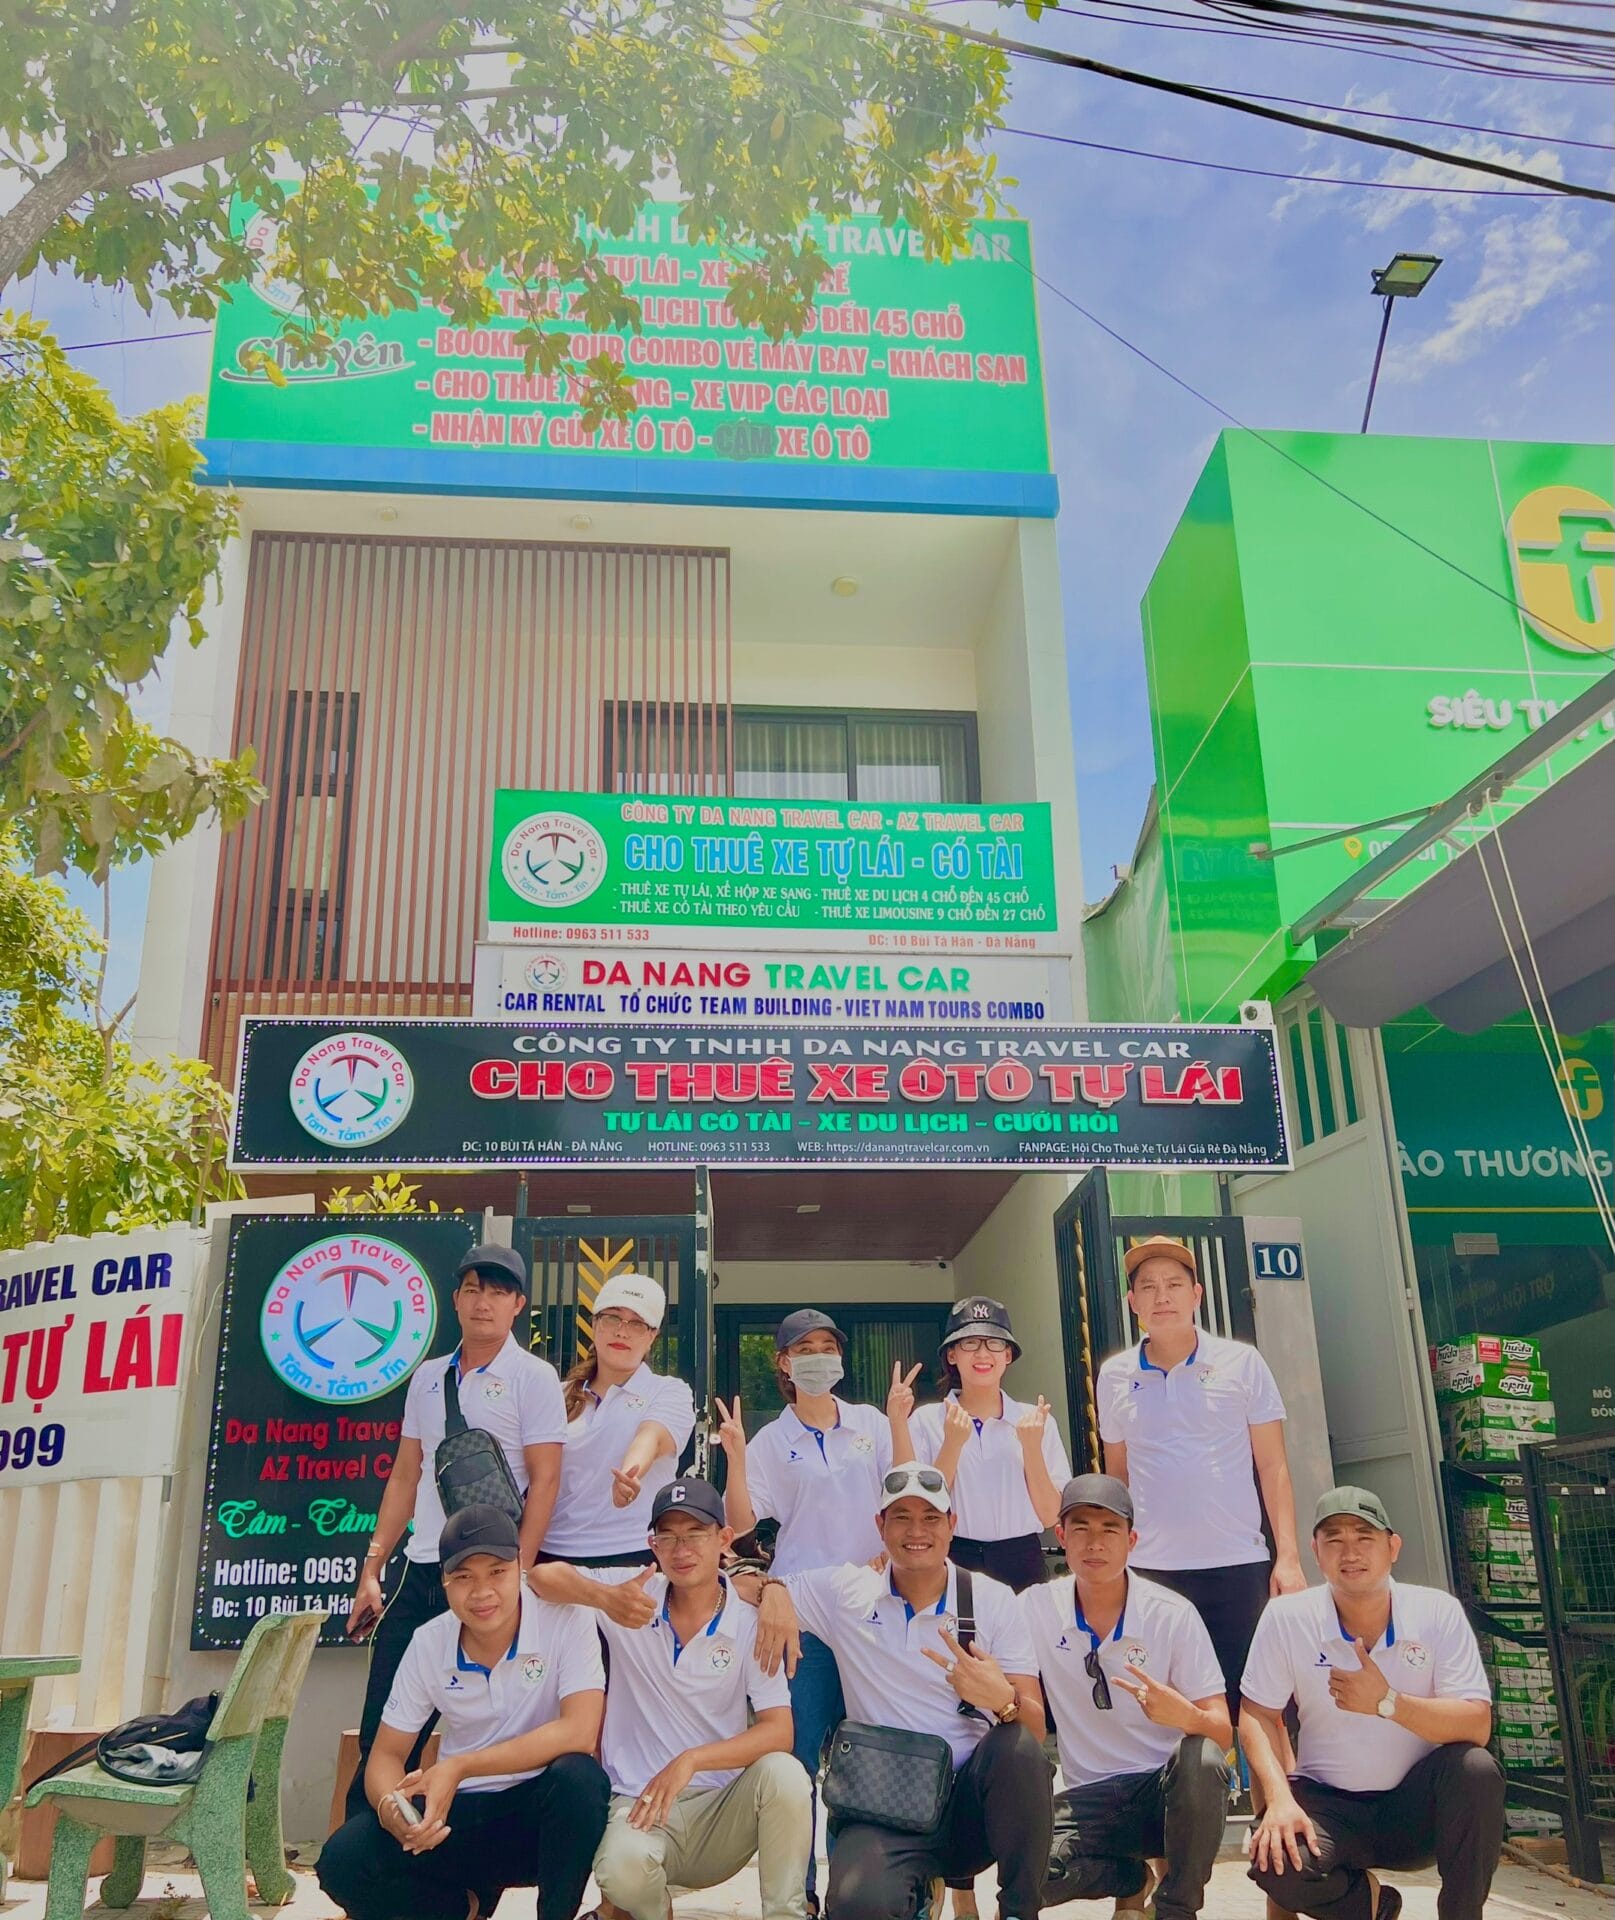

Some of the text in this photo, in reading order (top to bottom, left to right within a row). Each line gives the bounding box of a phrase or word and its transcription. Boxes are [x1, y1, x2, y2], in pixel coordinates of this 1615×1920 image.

[641, 253, 679, 286] LÁI
[643, 296, 702, 328] LỊCH
[874, 310, 908, 337] 45
[911, 304, 965, 341] CHỖ
[629, 338, 1028, 387] COMBO VÉ MÁY BAY KHÁCH SẠN
[434, 370, 889, 423] CHO THUÊ XE VIP CÁC LOẠI
[431, 408, 871, 460] NHẬN KÝ XE Ô TÔ XE Ô TÔ
[1427, 689, 1513, 730] SIÊU
[621, 800, 1024, 832] CÔNG TY NANG TRAVEL CAR AZ TRAVEL CAR
[624, 833, 1023, 884] CHO THUÊ XE TỰ LÁI CÓ TÀI
[620, 881, 812, 900] THUÊ XE XE SANG
[821, 886, 851, 902] THUÊ
[854, 889, 869, 901] XE
[872, 890, 889, 902] DU
[921, 890, 928, 902] 4
[986, 892, 1000, 904] 45
[620, 899, 651, 914] THUÊ
[654, 902, 669, 914] XE
[716, 903, 748, 916] THEO
[821, 904, 1015, 921] THUÊ XE LIMOUSINE 9 27
[513, 925, 650, 941] Hotline: 0963 511 533
[894, 935, 907, 947] 10
[582, 960, 631, 986] DA
[643, 961, 751, 988] NANG
[764, 964, 888, 993] TRAVEL
[897, 965, 971, 993] CAR
[504, 992, 538, 1012] CAR
[542, 992, 606, 1013] RENTAL
[646, 991, 692, 1014] CHỨC
[700, 996, 747, 1015] TEAM
[754, 996, 832, 1017] BUILDING
[844, 998, 881, 1018] VIET
[885, 1000, 925, 1018] NAM
[928, 1000, 982, 1019] TOURS
[987, 1001, 1045, 1020] COMBO
[512, 1031, 1192, 1059] CÔNG TY TNHH DA NANG TRAVEL CAR
[469, 1056, 1244, 1109] CHO THUÊ XE ÔTÔ TỰ LÁI
[603, 1110, 645, 1134] TỰ
[649, 1108, 693, 1132] LÁI
[698, 1108, 740, 1132] CÓ
[744, 1108, 792, 1131] TÀI
[817, 1112, 852, 1132] XE
[858, 1112, 898, 1132] DU
[904, 1112, 969, 1135] LỊCH
[462, 1140, 482, 1153] ĐC:
[484, 1140, 498, 1153] 10
[500, 1138, 520, 1153] BÙI
[521, 1138, 536, 1153] TÁ
[537, 1138, 563, 1153] HÁN
[648, 1141, 771, 1154] HOTLINE: 0963 511 533
[797, 1141, 990, 1156] WEB: https://danangtravelcar.com.vn
[1018, 1142, 1070, 1154] FANPAGE:
[1091, 1142, 1112, 1154] Cho
[1113, 1143, 1139, 1154] Thuê
[1141, 1144, 1155, 1155] Xe
[1171, 1143, 1187, 1155] Lái
[1454, 1145, 1612, 1177] THƯƠNG
[91, 1252, 173, 1296] CAR
[1258, 1247, 1298, 1276] 10
[267, 1286, 291, 1315] Da
[286, 1244, 342, 1282] Nang
[350, 1240, 411, 1275] Travel
[407, 1276, 426, 1315] Car
[2, 1304, 184, 1415] TỰ LÁI
[225, 1416, 402, 1450] Da Nang Trave
[259, 1456, 291, 1481] AZ
[296, 1454, 367, 1481] Travel
[671, 1486, 686, 1503] C
[218, 1499, 288, 1538] Tâm
[214, 1558, 298, 1586] Hotline:
[304, 1556, 357, 1584] 0963
[212, 1594, 266, 1618] Đc: 10
